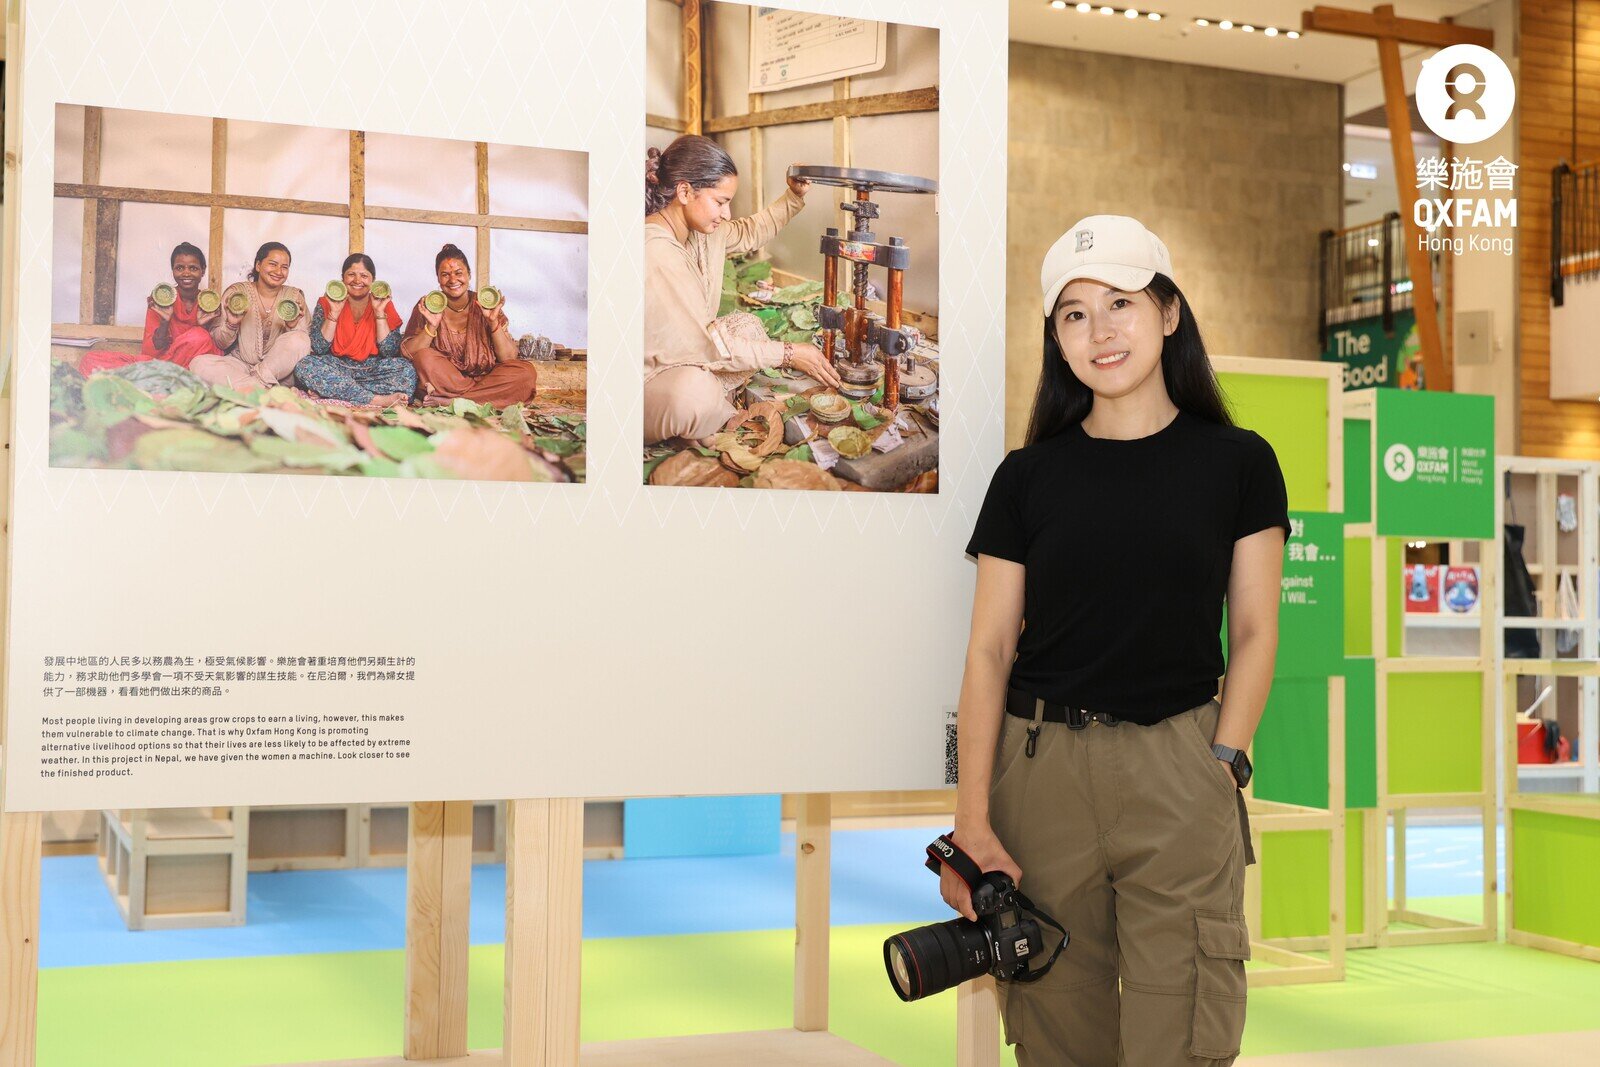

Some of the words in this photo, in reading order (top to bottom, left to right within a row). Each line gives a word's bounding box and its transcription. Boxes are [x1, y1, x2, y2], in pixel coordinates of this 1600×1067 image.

[1075, 228, 1094, 254] B
[1334, 329, 1371, 358] The
[1416, 460, 1449, 474] OXFAM
[1281, 575, 1314, 591] gainst
[1287, 590, 1307, 604] Will
[41, 717, 64, 725] Most
[65, 717, 96, 726] people
[97, 717, 123, 726] living
[134, 716, 182, 725] developing
[209, 717, 231, 725] grow
[295, 715, 321, 724] living,
[126, 729, 159, 737] climate
[160, 729, 195, 738] change.
[196, 728, 217, 736] That
[227, 728, 245, 737] why
[273, 728, 295, 737] Hong
[296, 727, 317, 736] Kong
[327, 726, 369, 736] promoting
[40, 743, 91, 751] alternative
[92, 742, 136, 750] livelihood
[137, 742, 171, 751] options
[184, 741, 203, 749] that
[283, 740, 307, 749] likely
[307, 740, 317, 748] to
[366, 739, 377, 748] by
[377, 739, 411, 747] extreme
[40, 756, 80, 764] weather.
[111, 755, 143, 765] project
[154, 754, 182, 764] Nepal,
[220, 754, 244, 763] given
[57, 769, 94, 777] finished
[95, 768, 134, 778] product.
